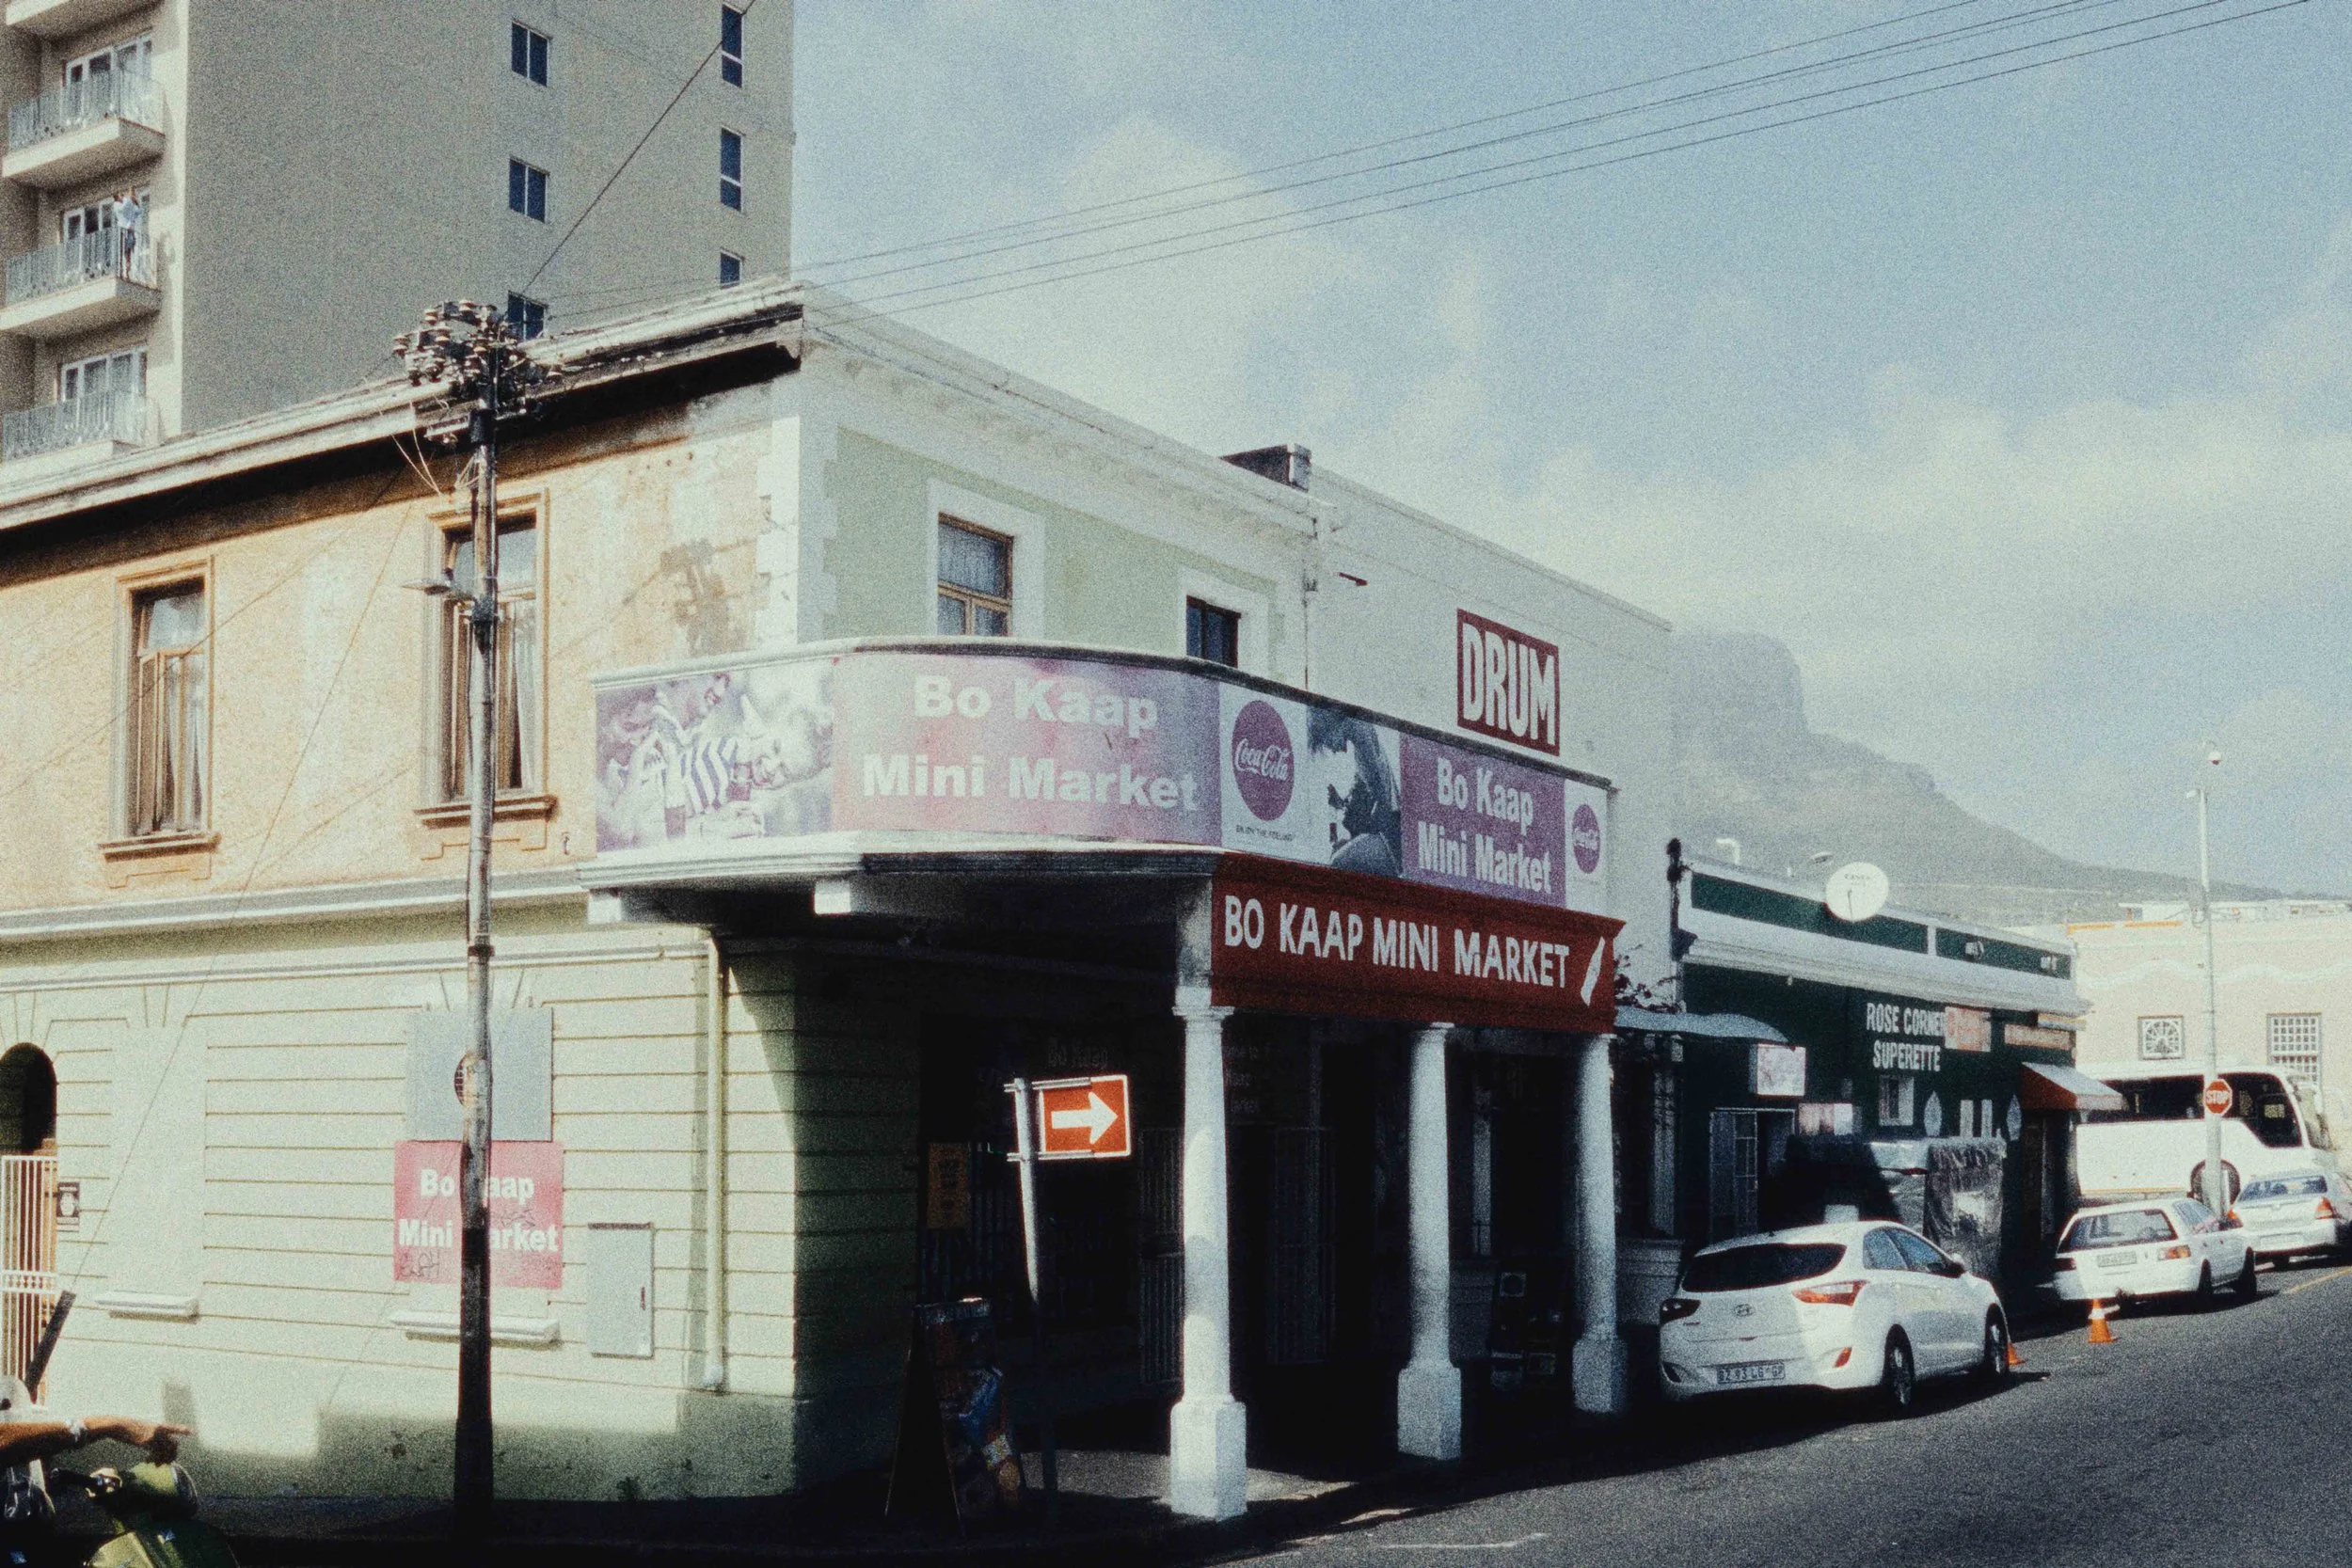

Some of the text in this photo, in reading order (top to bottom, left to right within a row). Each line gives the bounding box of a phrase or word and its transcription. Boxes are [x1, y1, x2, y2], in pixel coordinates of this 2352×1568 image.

[914, 674, 1159, 739] Bo Kaap
[1463, 622, 1555, 745] DRUM
[863, 754, 1197, 812] Mini Market
[1438, 757, 1534, 835] Bo Kaap
[1418, 821, 1552, 894] Mini Market
[1225, 895, 1569, 989] BO KAAP MINI MARKET
[1867, 1002, 1899, 1033] ROSE
[1873, 1039, 1941, 1071] SUPERETTE
[2206, 1090, 2229, 1104] STOP
[421, 1169, 534, 1206] Bo aap
[399, 1218, 558, 1252] Mini arket
